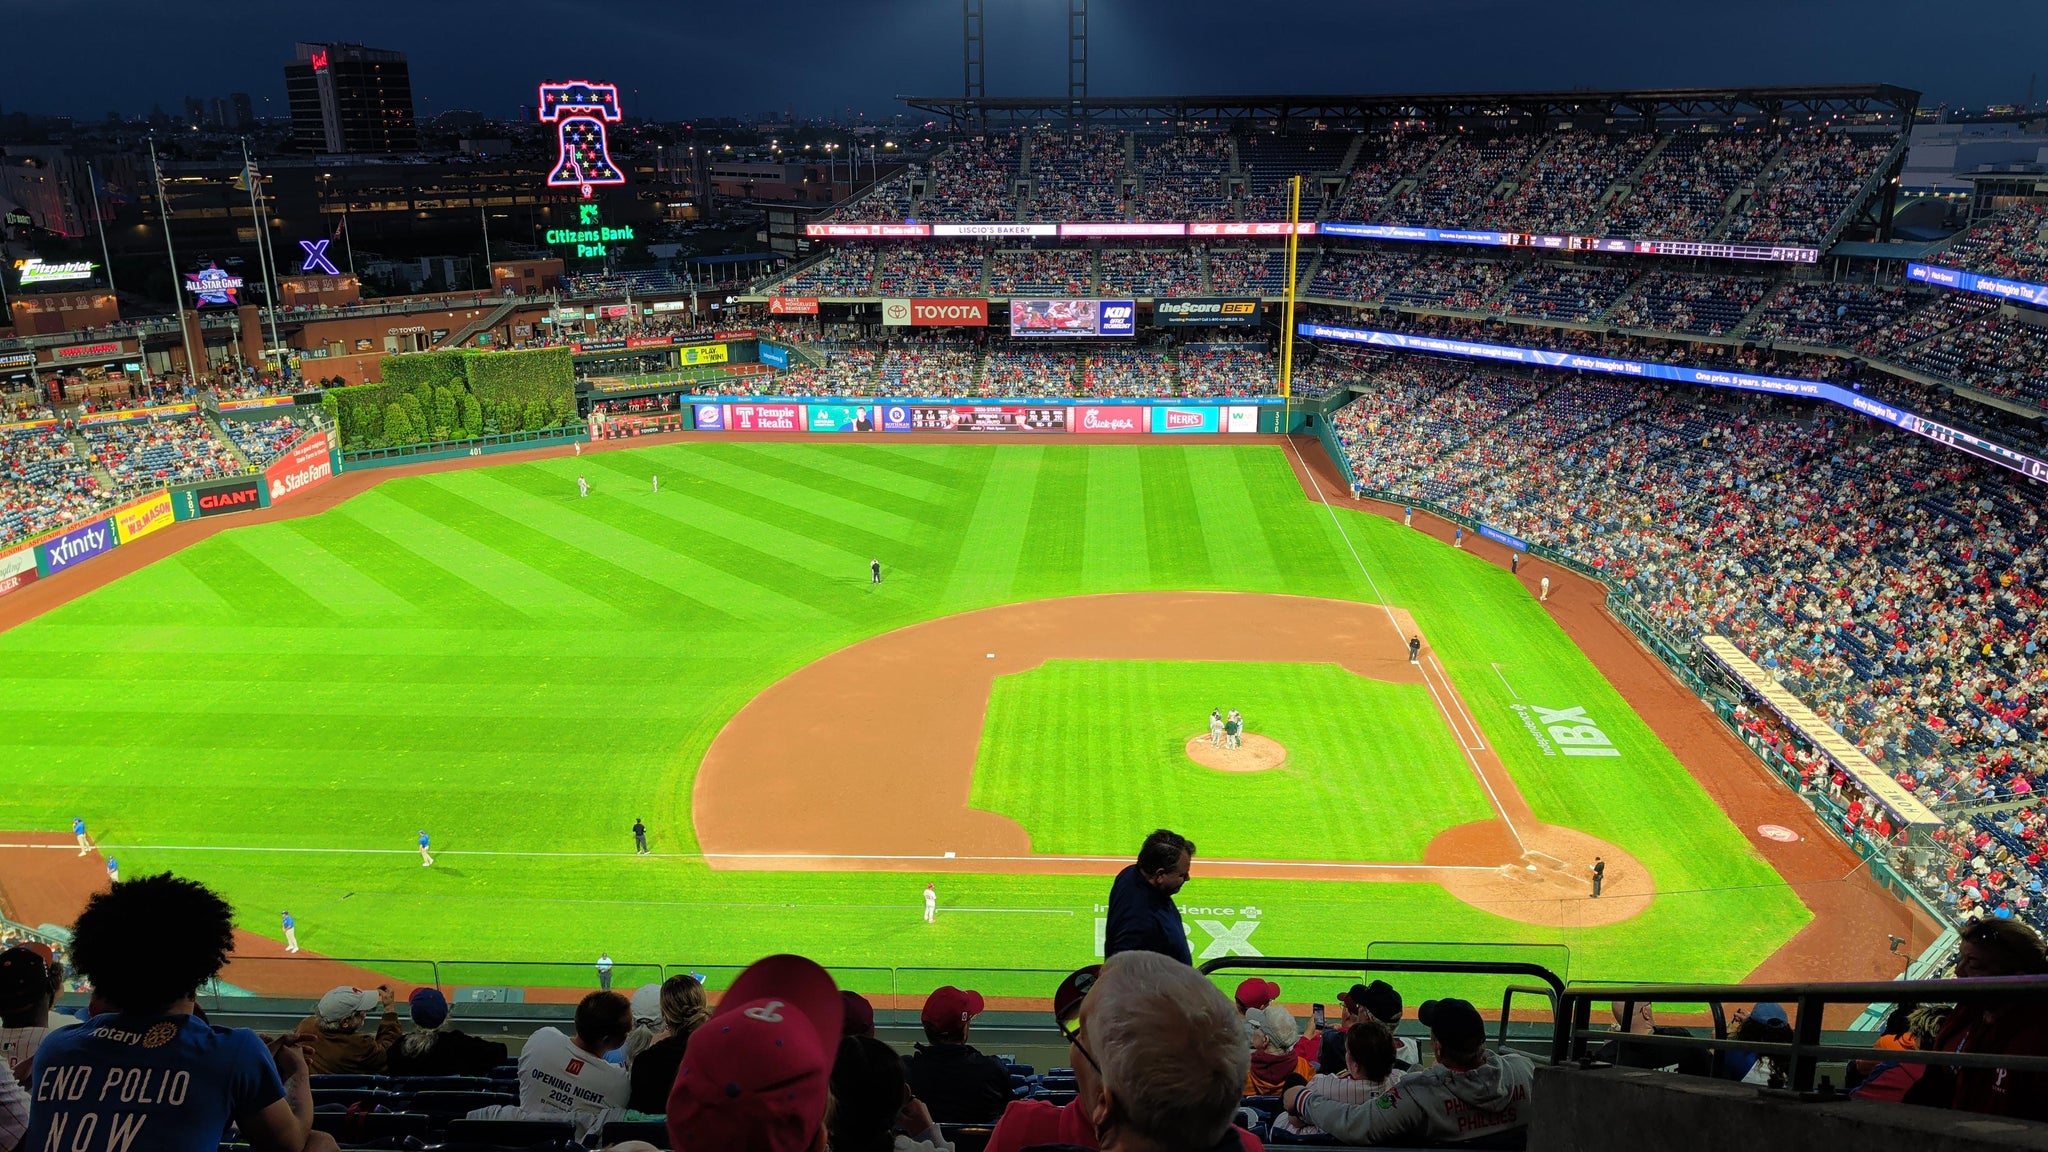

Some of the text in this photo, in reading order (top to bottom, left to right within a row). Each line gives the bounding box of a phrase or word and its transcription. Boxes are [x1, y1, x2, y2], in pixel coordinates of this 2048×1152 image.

[546, 225, 634, 244] Citizens Bank
[299, 239, 340, 275] X
[577, 242, 607, 258] Park
[19, 259, 93, 276] Fitzpatrick
[186, 278, 243, 291] ALL STAR GAME
[1996, 282, 2020, 297] Imagine
[2020, 286, 2034, 298] That
[915, 306, 981, 319] TOYOTA
[1159, 302, 1254, 313] theScore BET
[1333, 330, 1354, 339] Imagine
[1355, 331, 1367, 340] That
[1572, 358, 1641, 373] xfinity Imagine That
[1696, 372, 1710, 381] One
[1711, 374, 1731, 383] price.
[1738, 378, 1760, 387] years.
[1761, 380, 1799, 393] Same-day
[757, 407, 795, 417] Temple
[758, 418, 793, 428] Health
[186, 491, 195, 518] 387
[200, 489, 257, 509] GIANT
[67, 516, 97, 531] ASPLUNDH
[29, 531, 61, 547] ASPLUNDH
[50, 528, 105, 566] xfinity
[1530, 705, 1621, 756] IBX
[1767, 689, 1882, 776] PHILADELPHIA
[1883, 789, 1920, 814] HOME
[37, 1065, 191, 1105] END POLIO
[532, 1068, 604, 1104] OPENING NIGHT
[549, 1090, 574, 1106] 2025
[44, 1111, 147, 1152] NOW
